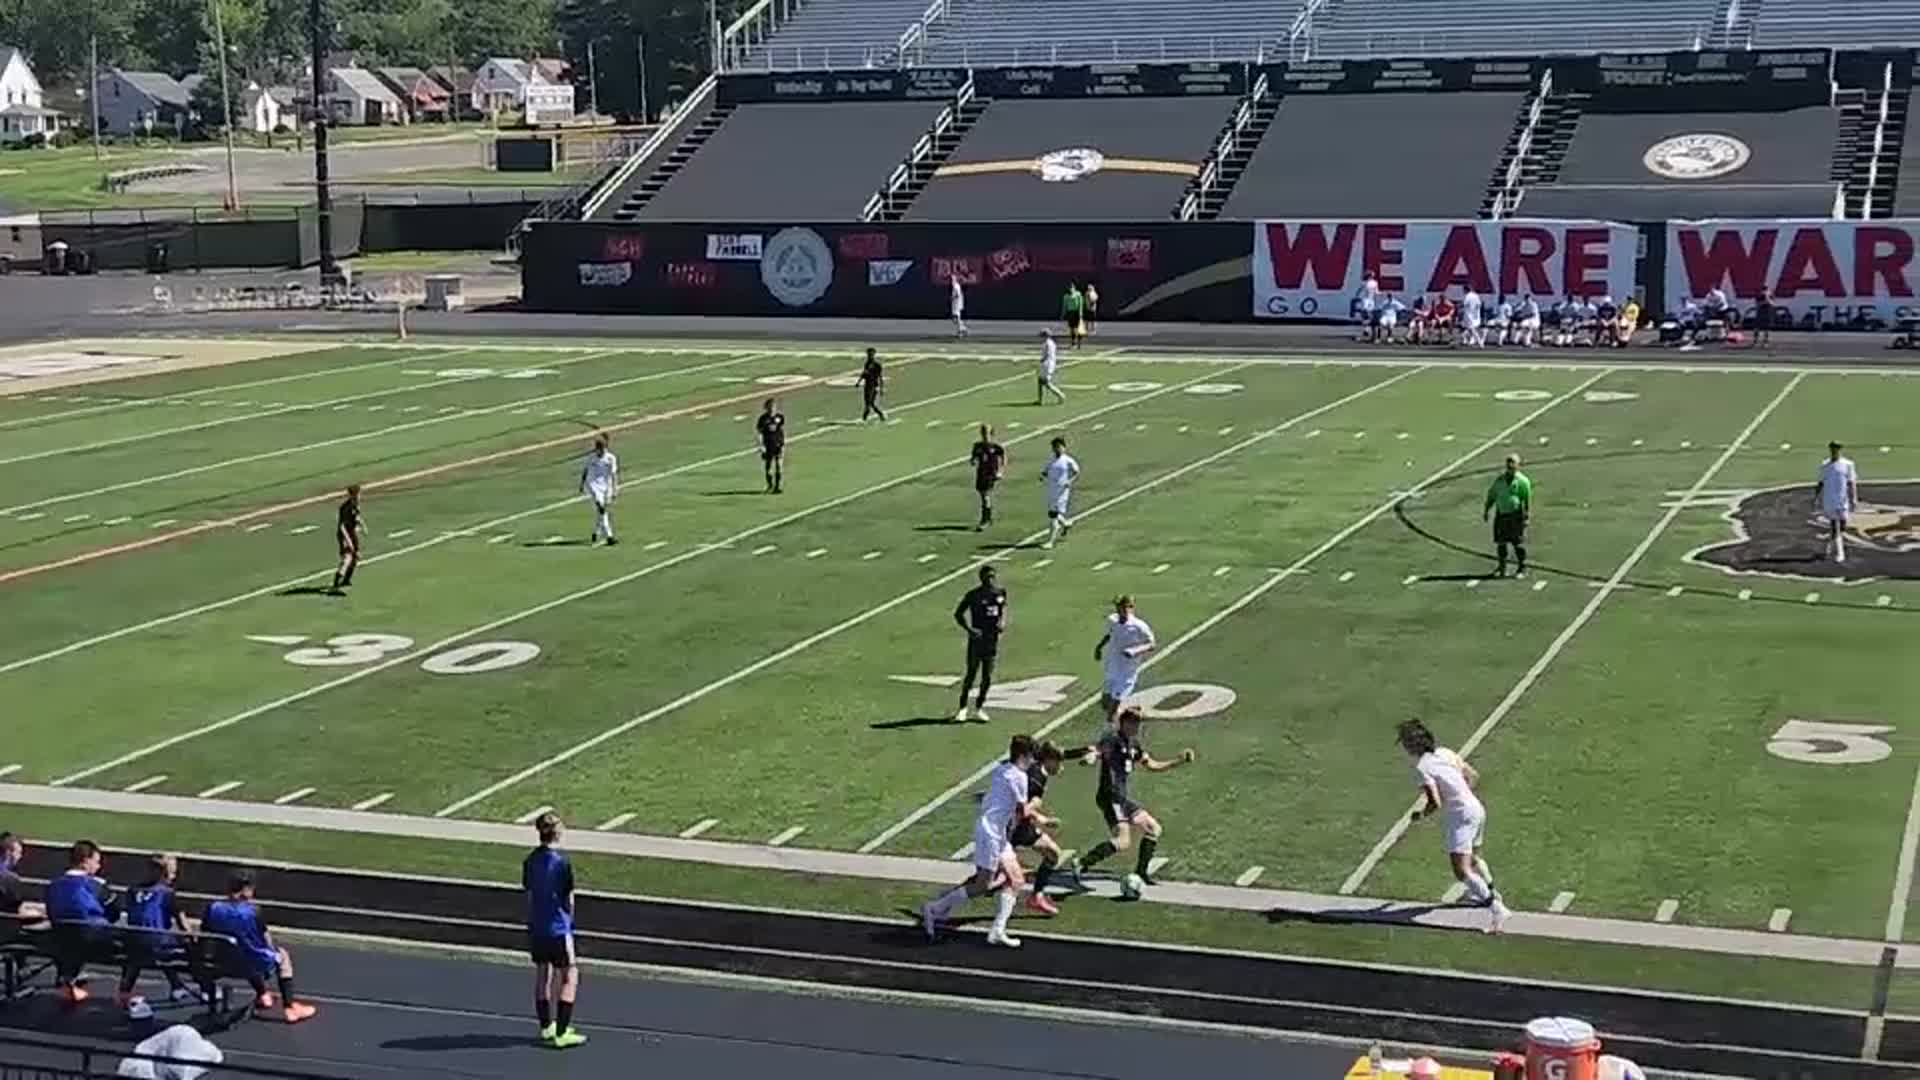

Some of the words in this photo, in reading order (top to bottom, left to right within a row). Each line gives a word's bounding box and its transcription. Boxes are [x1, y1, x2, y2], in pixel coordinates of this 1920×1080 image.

[1266, 223, 1406, 291] WE
[1426, 226, 1610, 296] ARE
[1267, 296, 1319, 314] GO
[284, 633, 541, 674] 30
[1545, 1058, 1567, 1080] G
